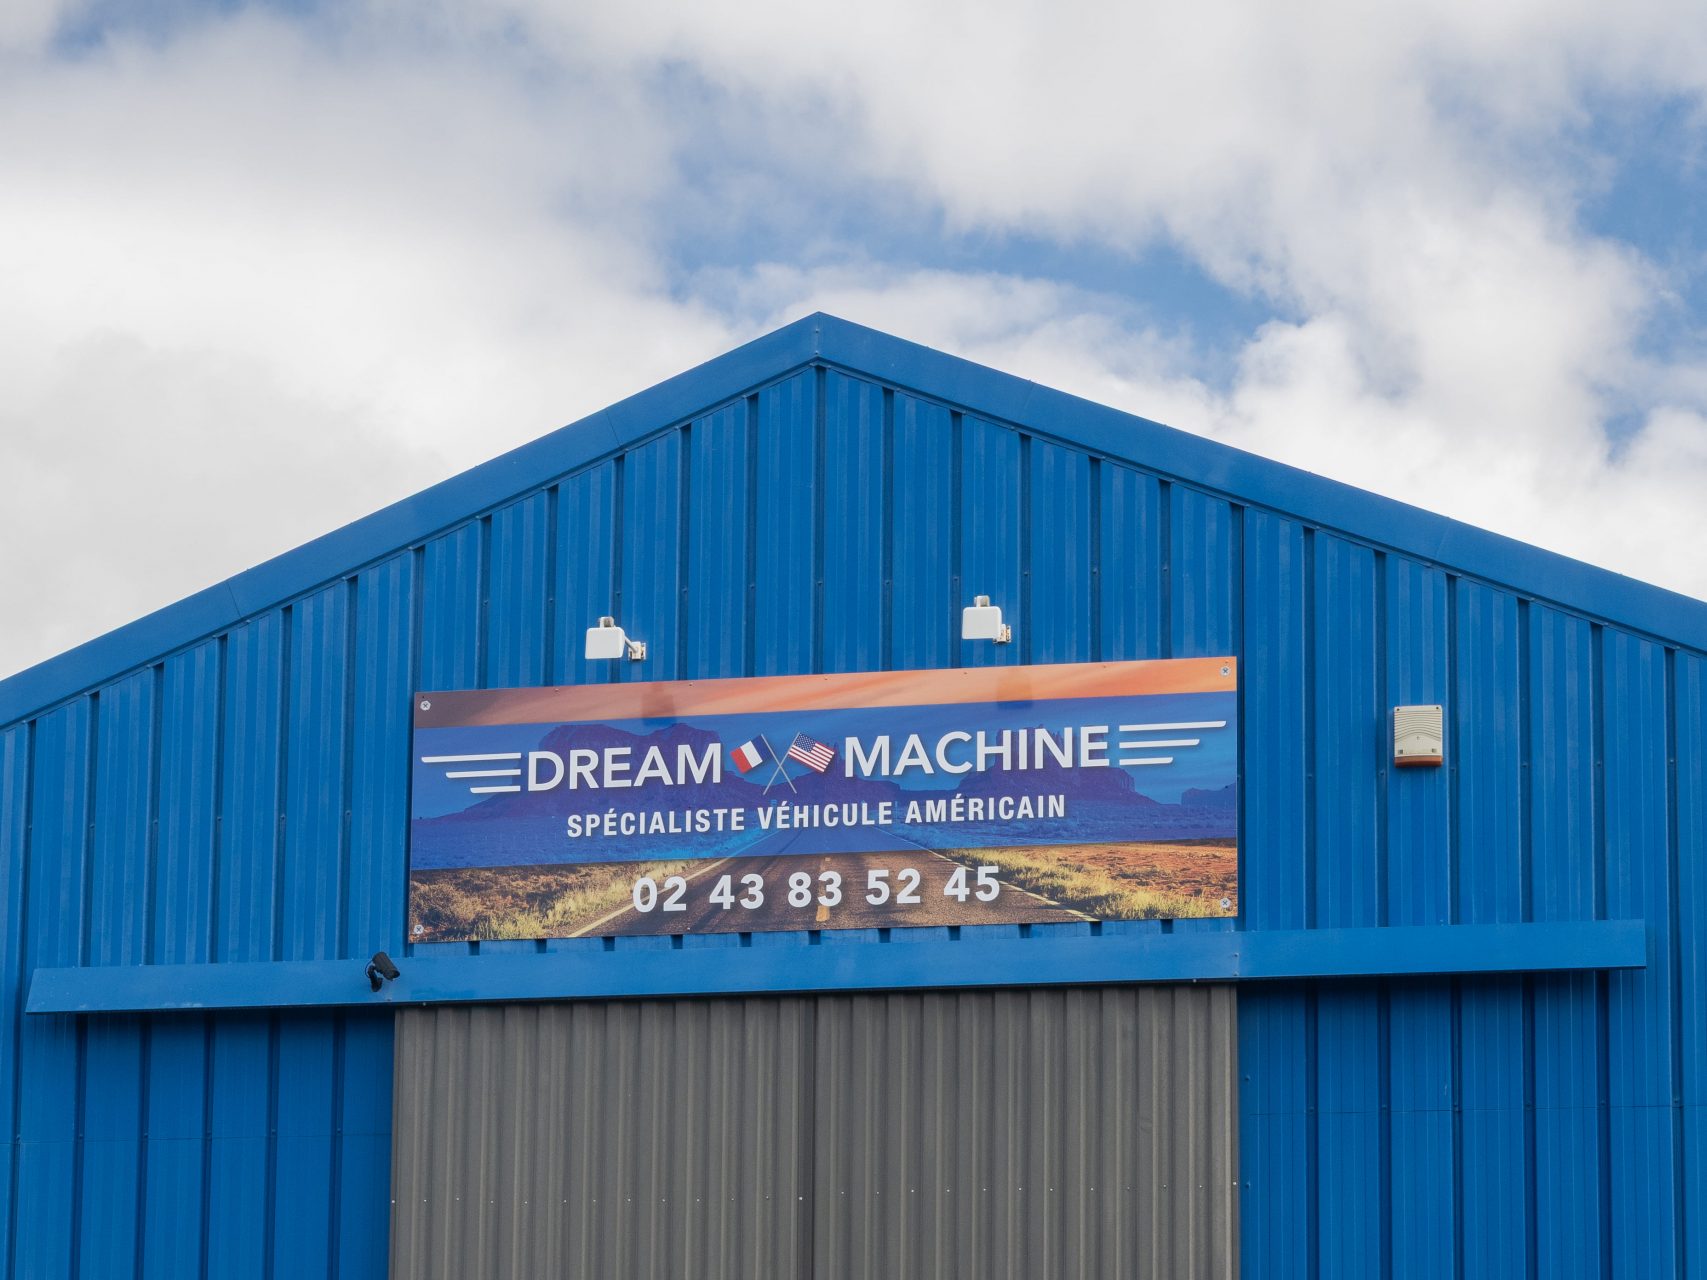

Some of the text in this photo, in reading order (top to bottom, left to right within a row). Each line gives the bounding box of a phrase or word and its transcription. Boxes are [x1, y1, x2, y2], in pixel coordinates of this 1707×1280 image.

[527, 725, 1110, 793] DREAM MACHINE
[567, 793, 1066, 838] SPÉCIALISTE VÉHICULE AMÉRICAIN
[632, 865, 1000, 913] 02 43 83 52 45
